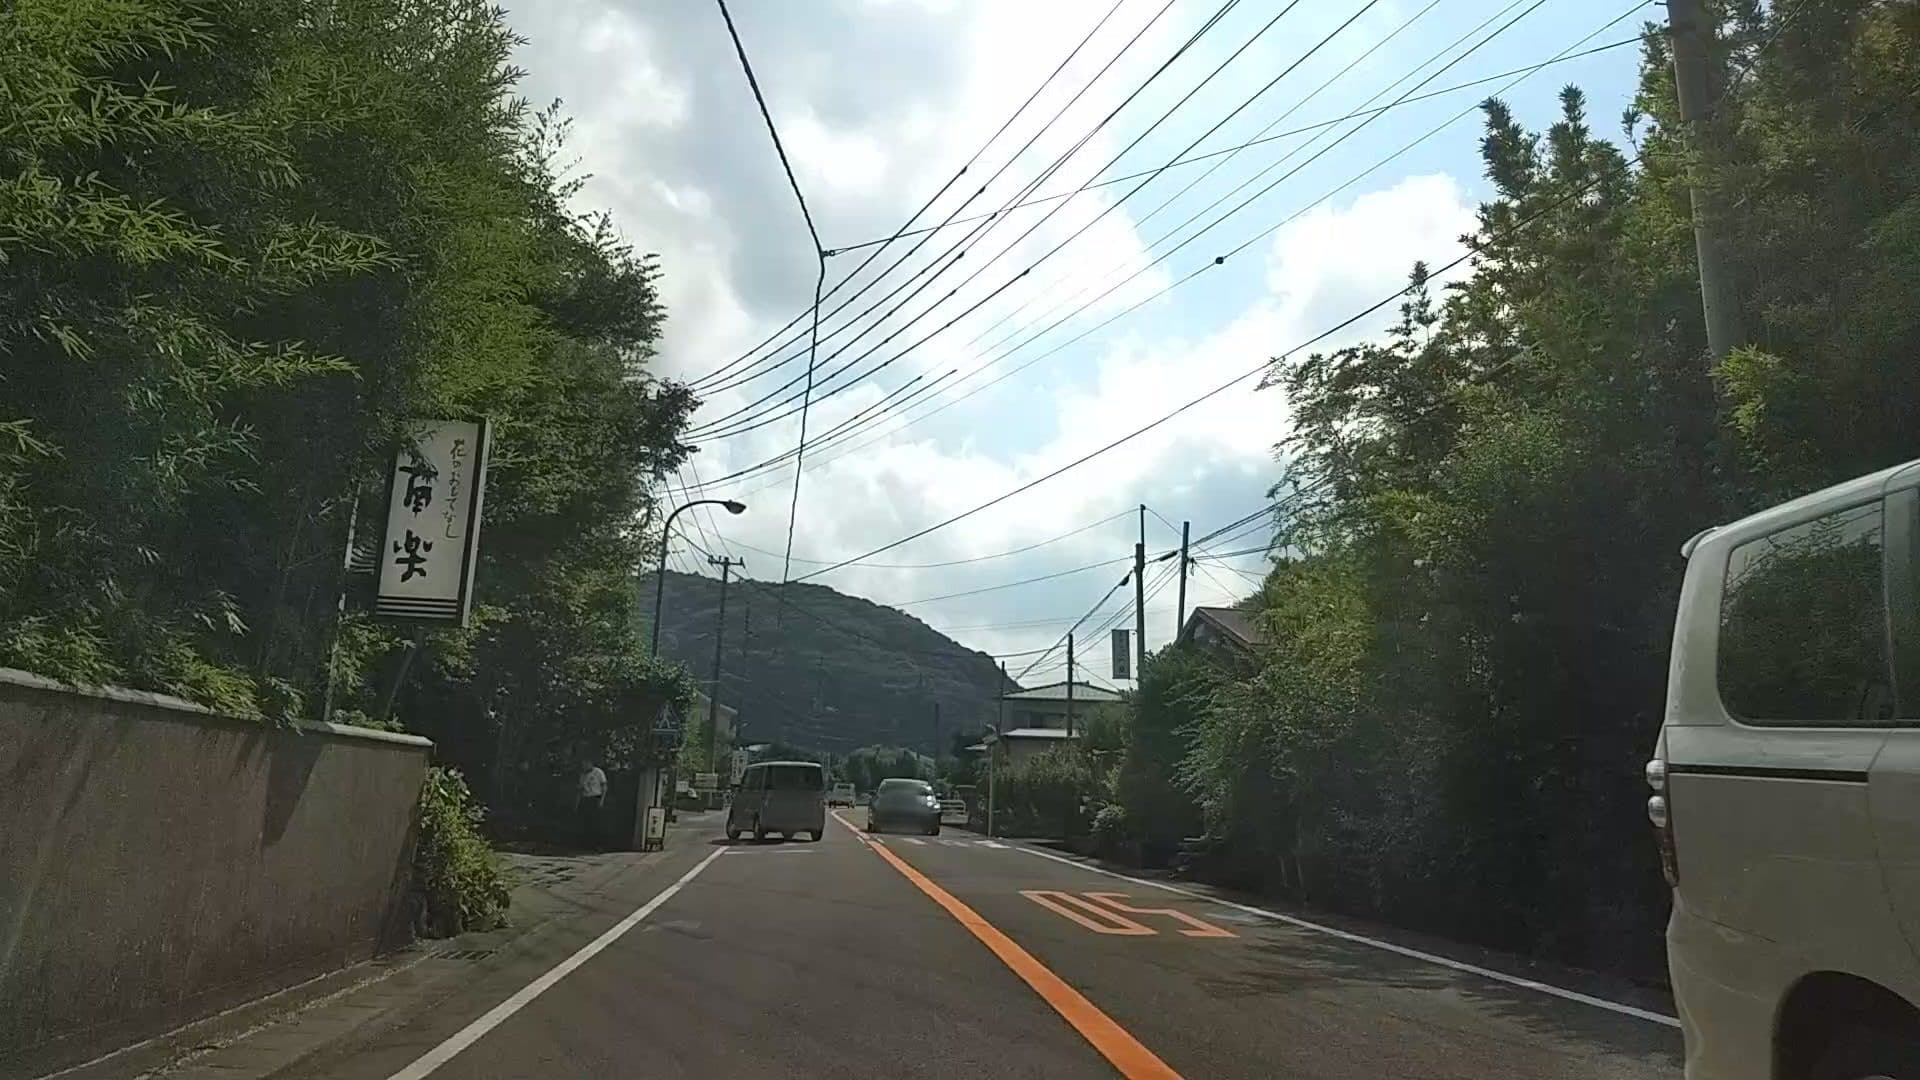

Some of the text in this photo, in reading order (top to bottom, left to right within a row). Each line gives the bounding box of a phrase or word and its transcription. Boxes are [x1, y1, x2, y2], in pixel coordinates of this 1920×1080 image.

[441, 439, 467, 538] 花のおもてなし
